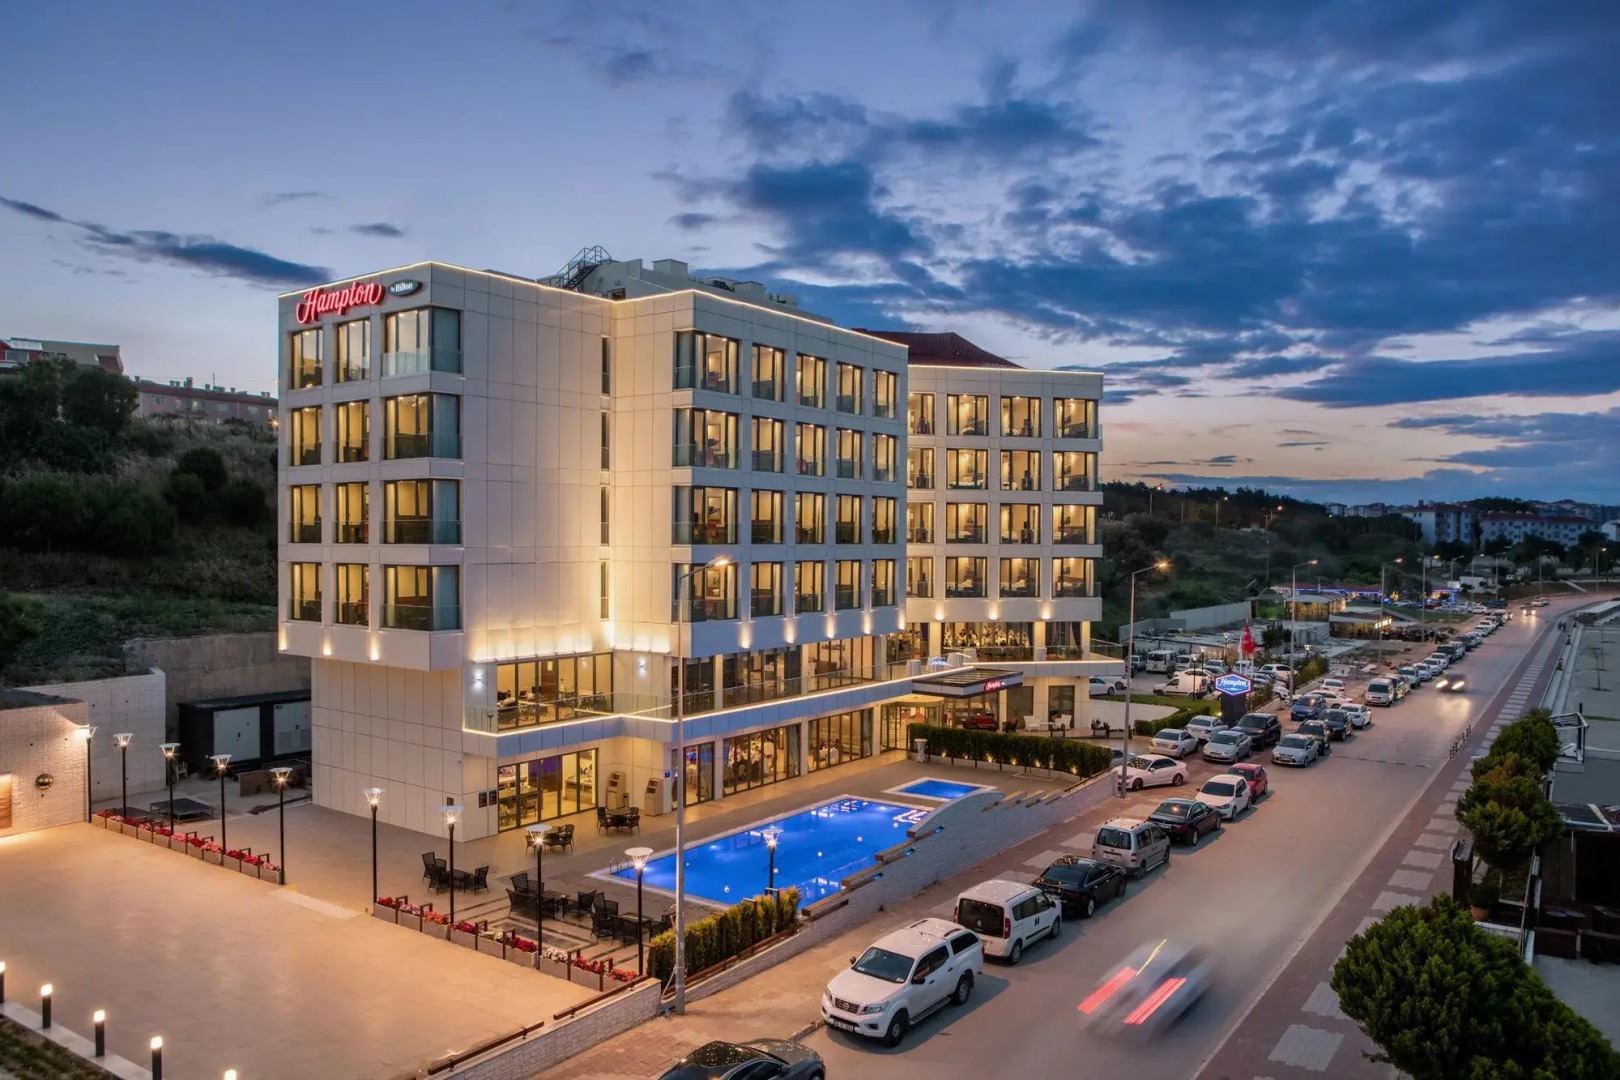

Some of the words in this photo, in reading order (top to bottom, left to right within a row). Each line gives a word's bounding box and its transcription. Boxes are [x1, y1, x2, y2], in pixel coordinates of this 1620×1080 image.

[296, 282, 385, 324] Hampton
[395, 281, 413, 293] Hilton
[1217, 677, 1249, 688] Hampton
